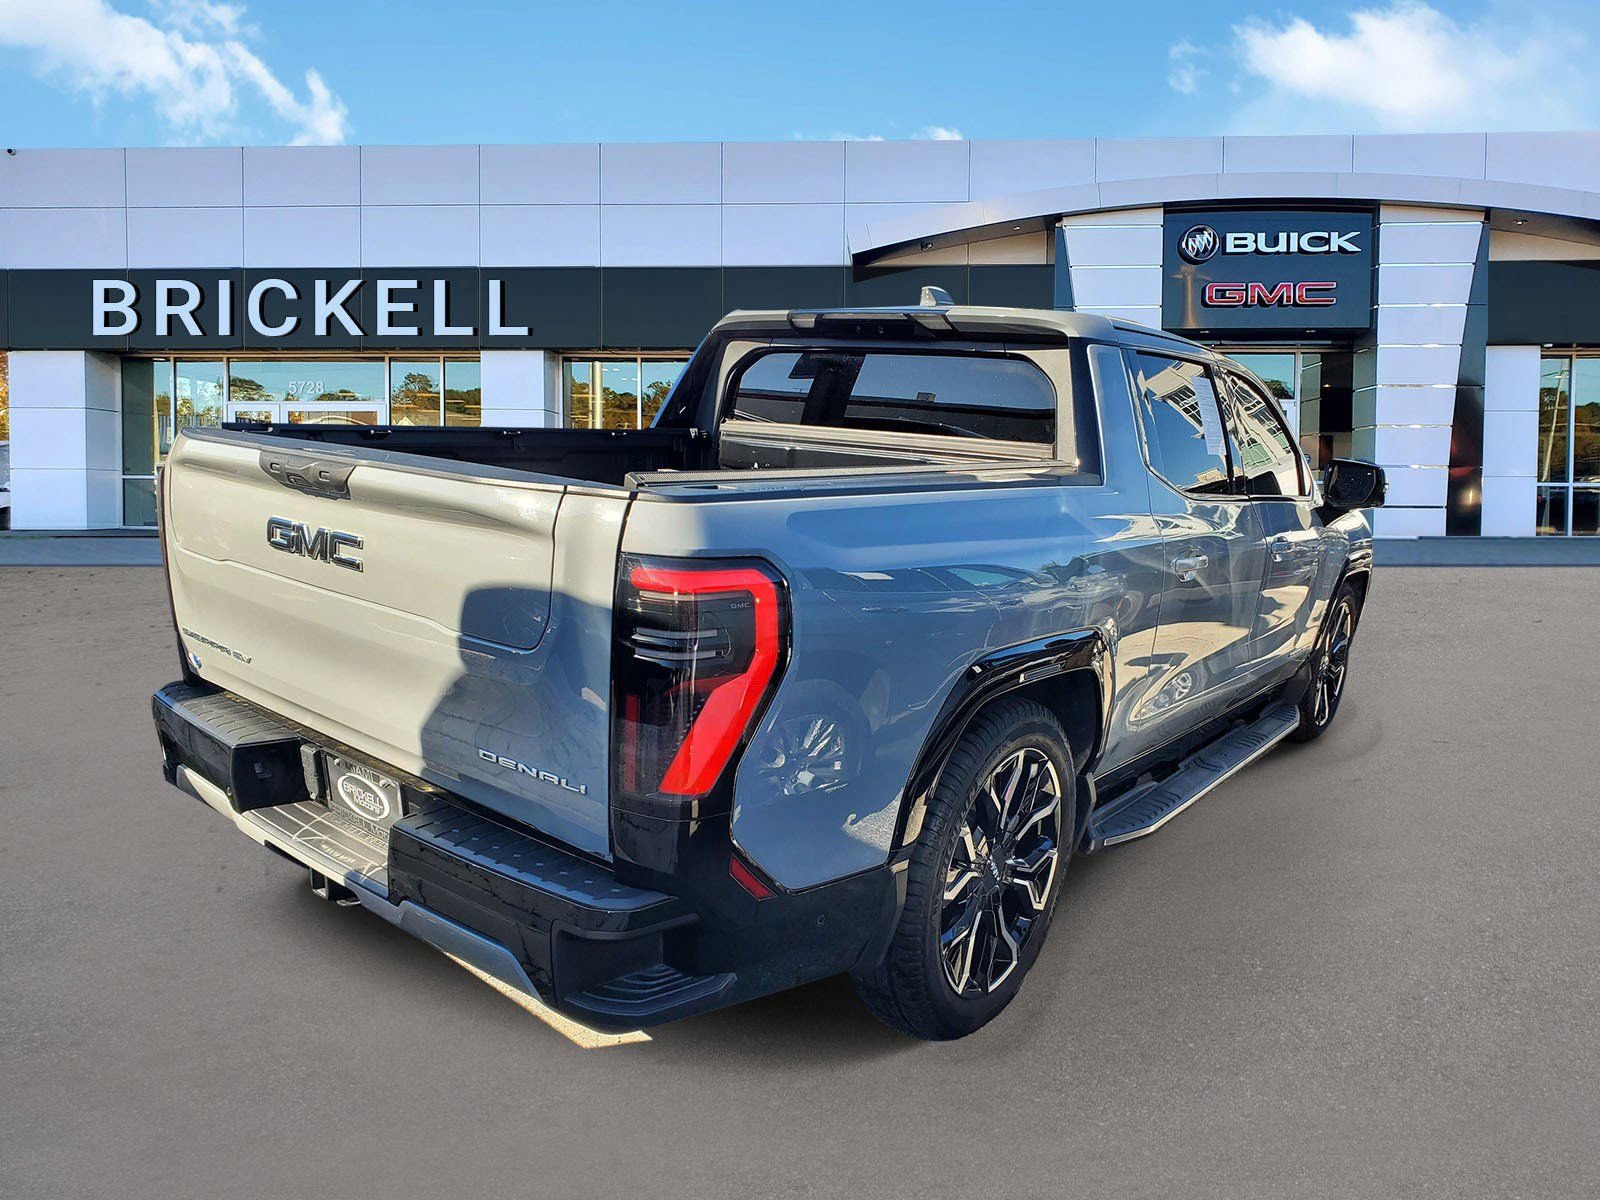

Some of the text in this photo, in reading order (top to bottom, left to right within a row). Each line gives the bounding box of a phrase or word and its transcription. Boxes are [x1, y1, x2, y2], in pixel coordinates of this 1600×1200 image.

[1226, 231, 1362, 253] BUICK
[92, 278, 530, 337] BRICKELL
[1206, 281, 1337, 305] GMC
[288, 381, 325, 394] 5728
[267, 516, 364, 573] GMC
[479, 748, 587, 795] DENALI
[343, 780, 384, 809] BRICKELL
